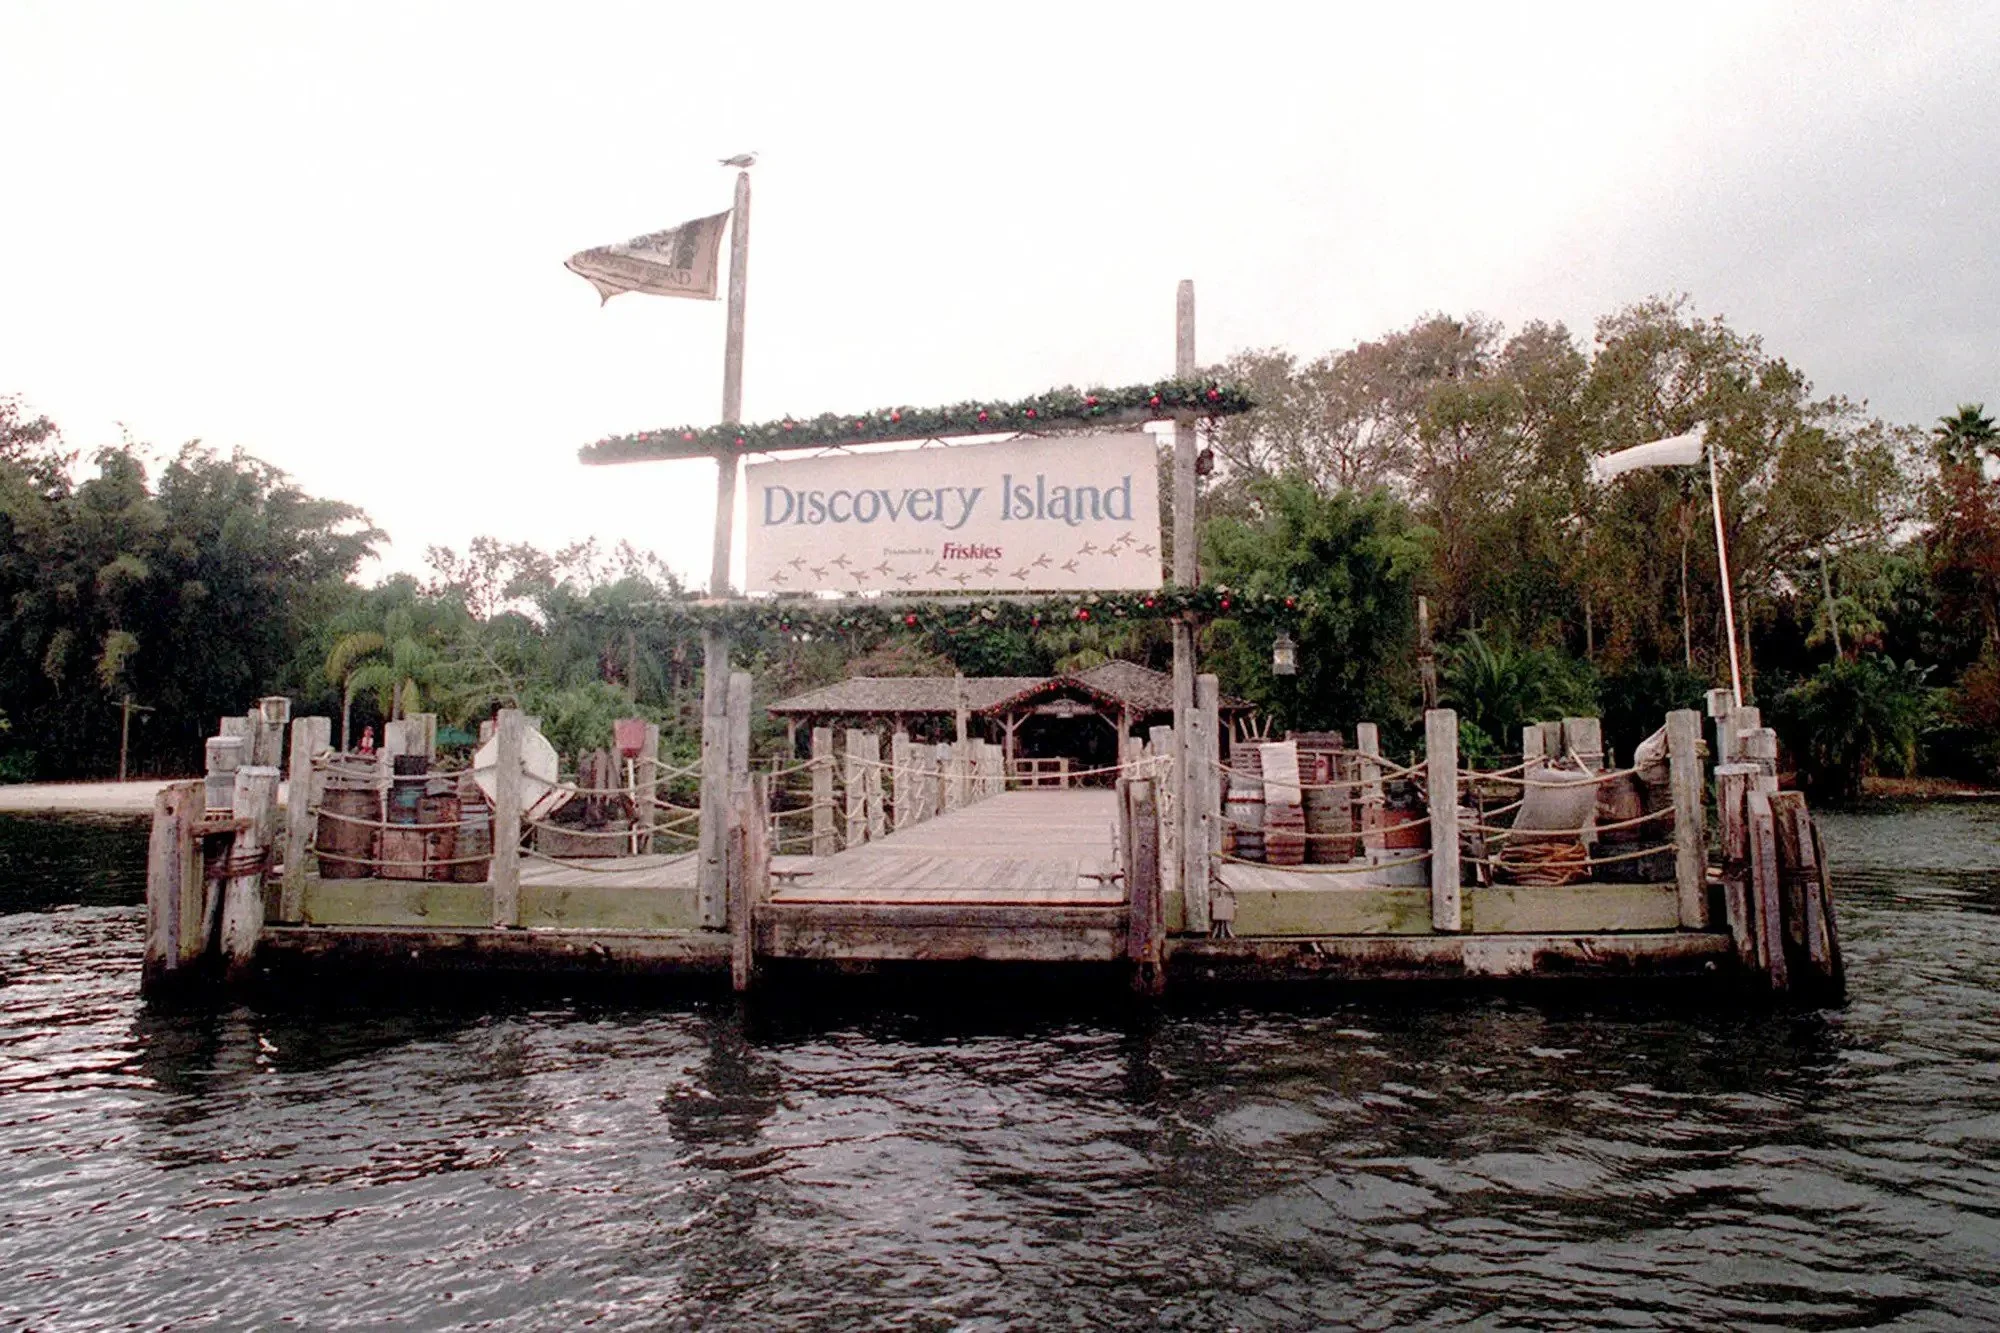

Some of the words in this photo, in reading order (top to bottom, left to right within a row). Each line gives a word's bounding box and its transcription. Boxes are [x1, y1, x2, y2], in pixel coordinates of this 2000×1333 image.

[762, 486, 983, 530] Discovery
[1001, 474, 1133, 526] Island
[943, 542, 1003, 560] Friskies
